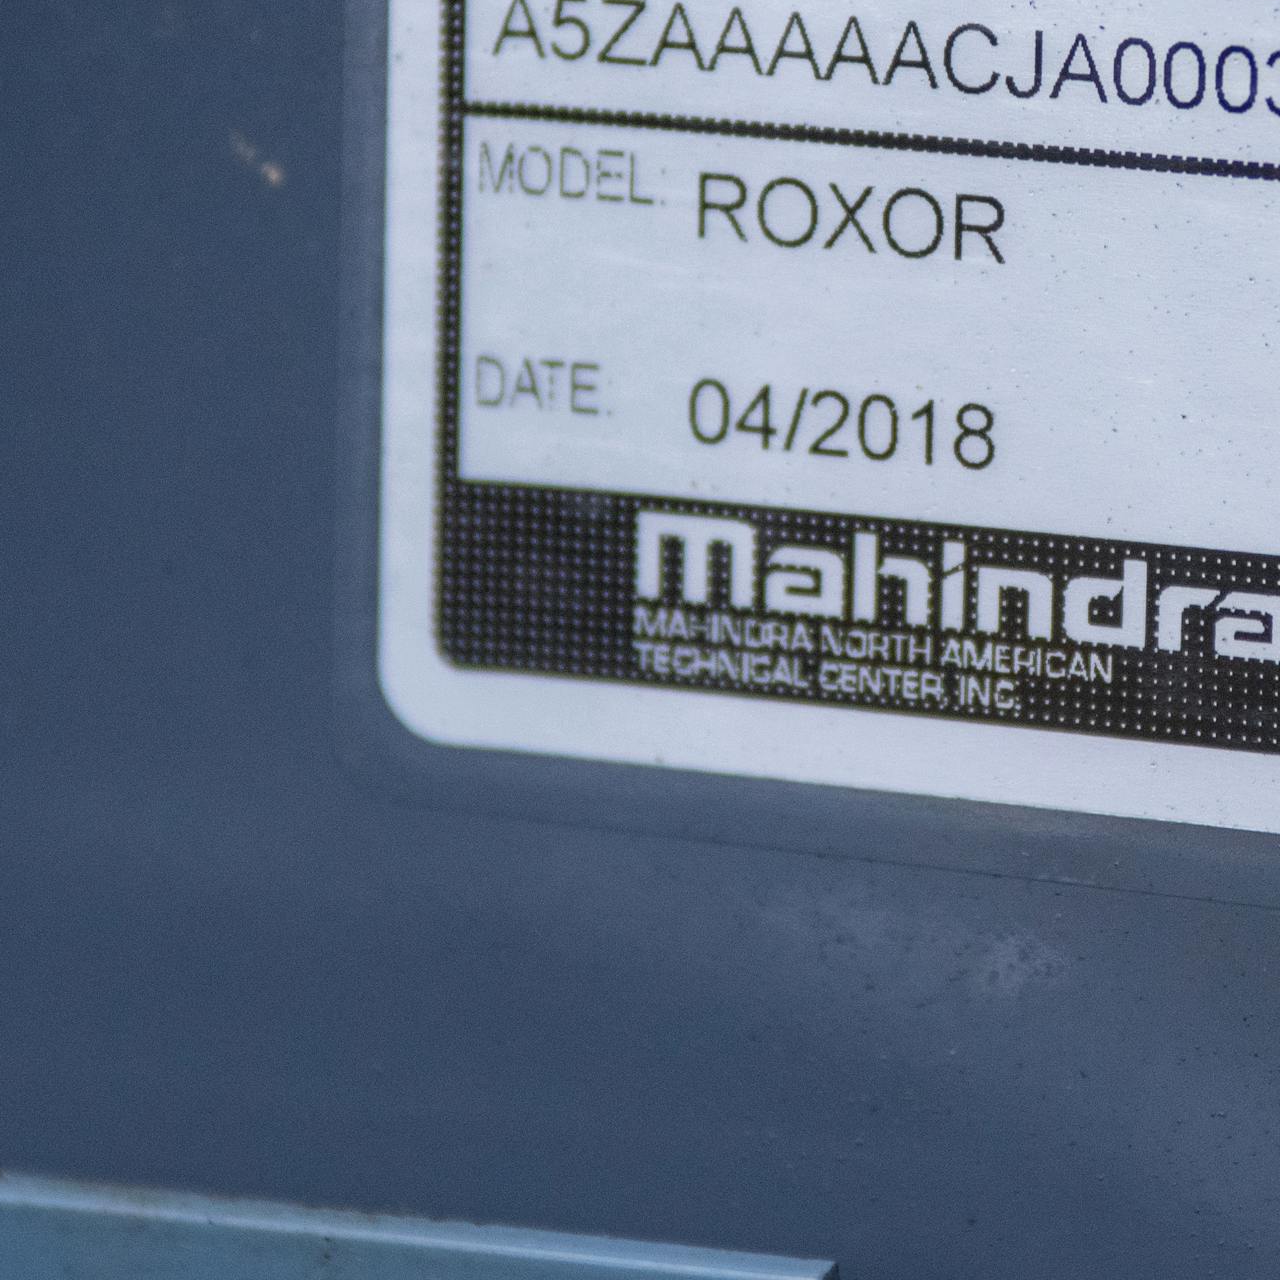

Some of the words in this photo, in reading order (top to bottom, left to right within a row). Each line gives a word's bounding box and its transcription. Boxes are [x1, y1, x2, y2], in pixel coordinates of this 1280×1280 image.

[697, 172, 1006, 265] ROXOR
[688, 378, 996, 471] 04/2018
[632, 640, 810, 688] TECHNICAL
[633, 605, 813, 653] MAHINDRA
[820, 623, 932, 666] NORTH
[941, 638, 1112, 684] AMERICAN
